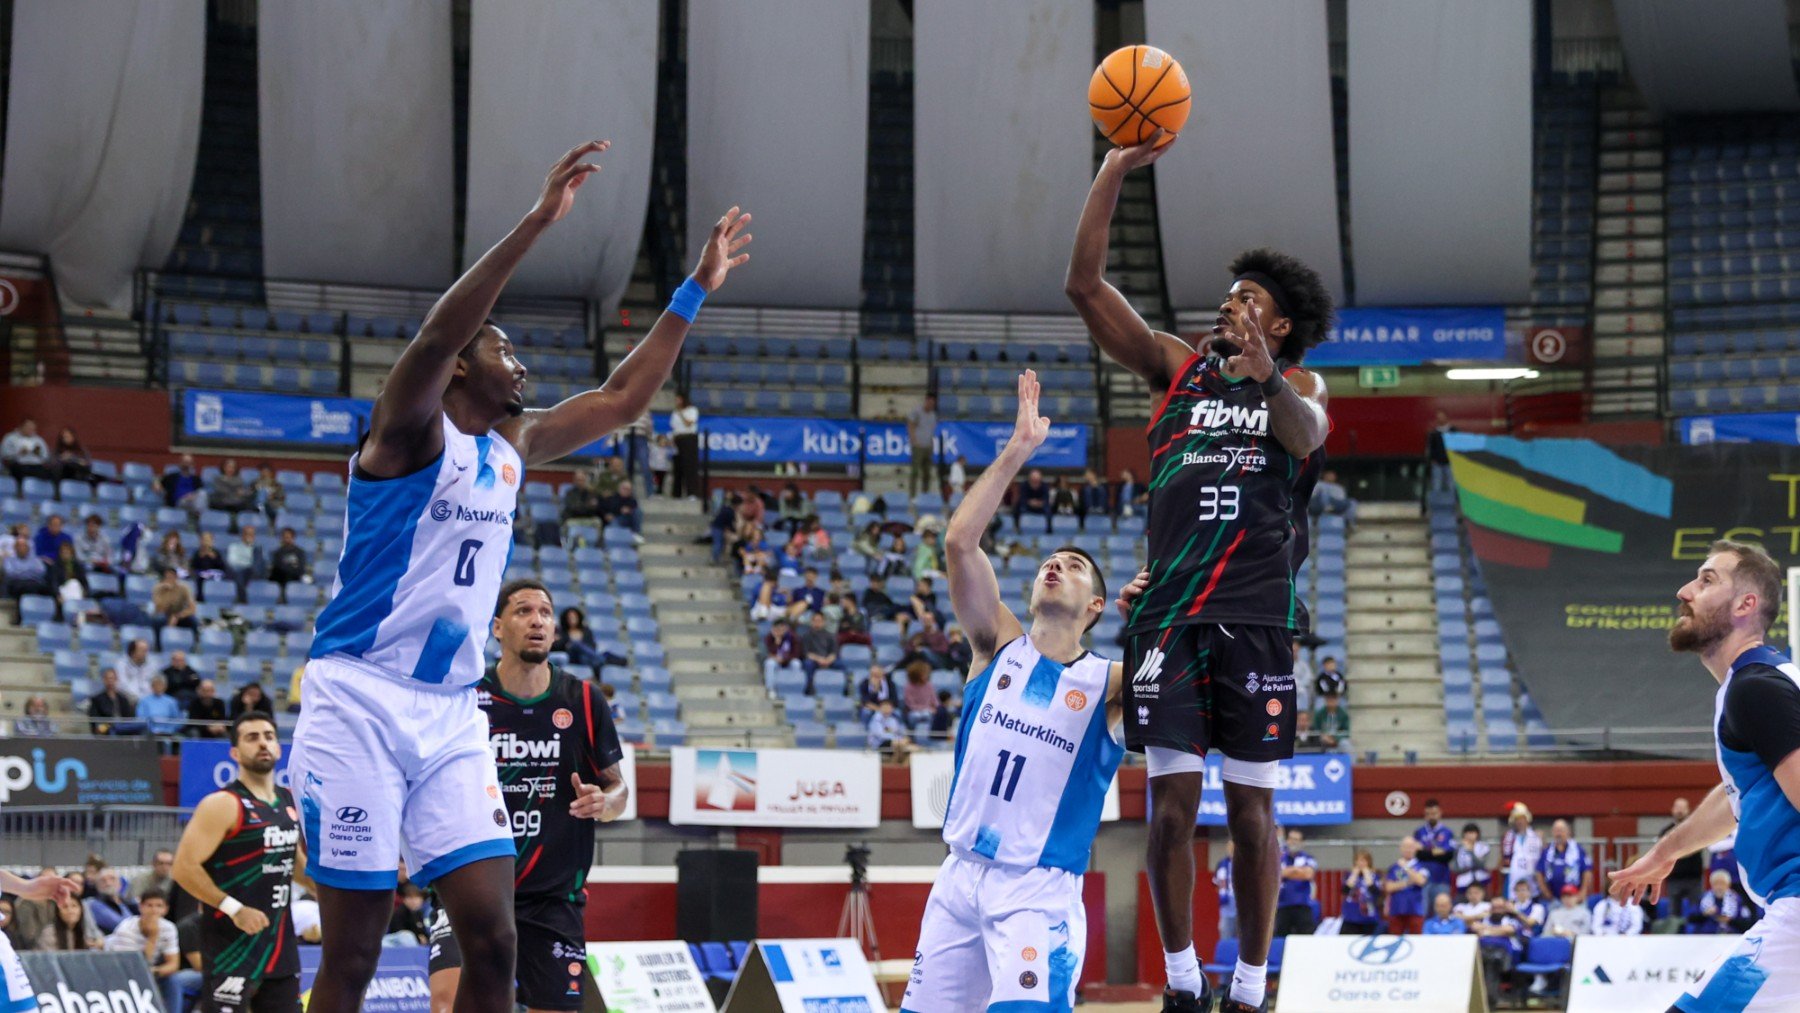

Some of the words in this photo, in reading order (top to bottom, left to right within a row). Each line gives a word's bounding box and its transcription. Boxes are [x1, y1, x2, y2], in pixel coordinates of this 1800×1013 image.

[1432, 328, 1494, 342] arena
[1543, 335, 1556, 352] 2
[1190, 399, 1268, 432] fibwi
[1199, 485, 1240, 521] 33
[453, 538, 484, 587] 0
[1262, 683, 1272, 691] de
[993, 710, 1076, 754] Naturklima
[491, 733, 561, 759] fibwi
[989, 749, 1027, 802] 11
[331, 823, 372, 833] HYUNDAI
[512, 810, 542, 837] 99
[355, 834, 373, 842] Car
[271, 884, 290, 908] 30
[1334, 969, 1420, 983] HYUNDAI
[1388, 987, 1421, 1001] Car
